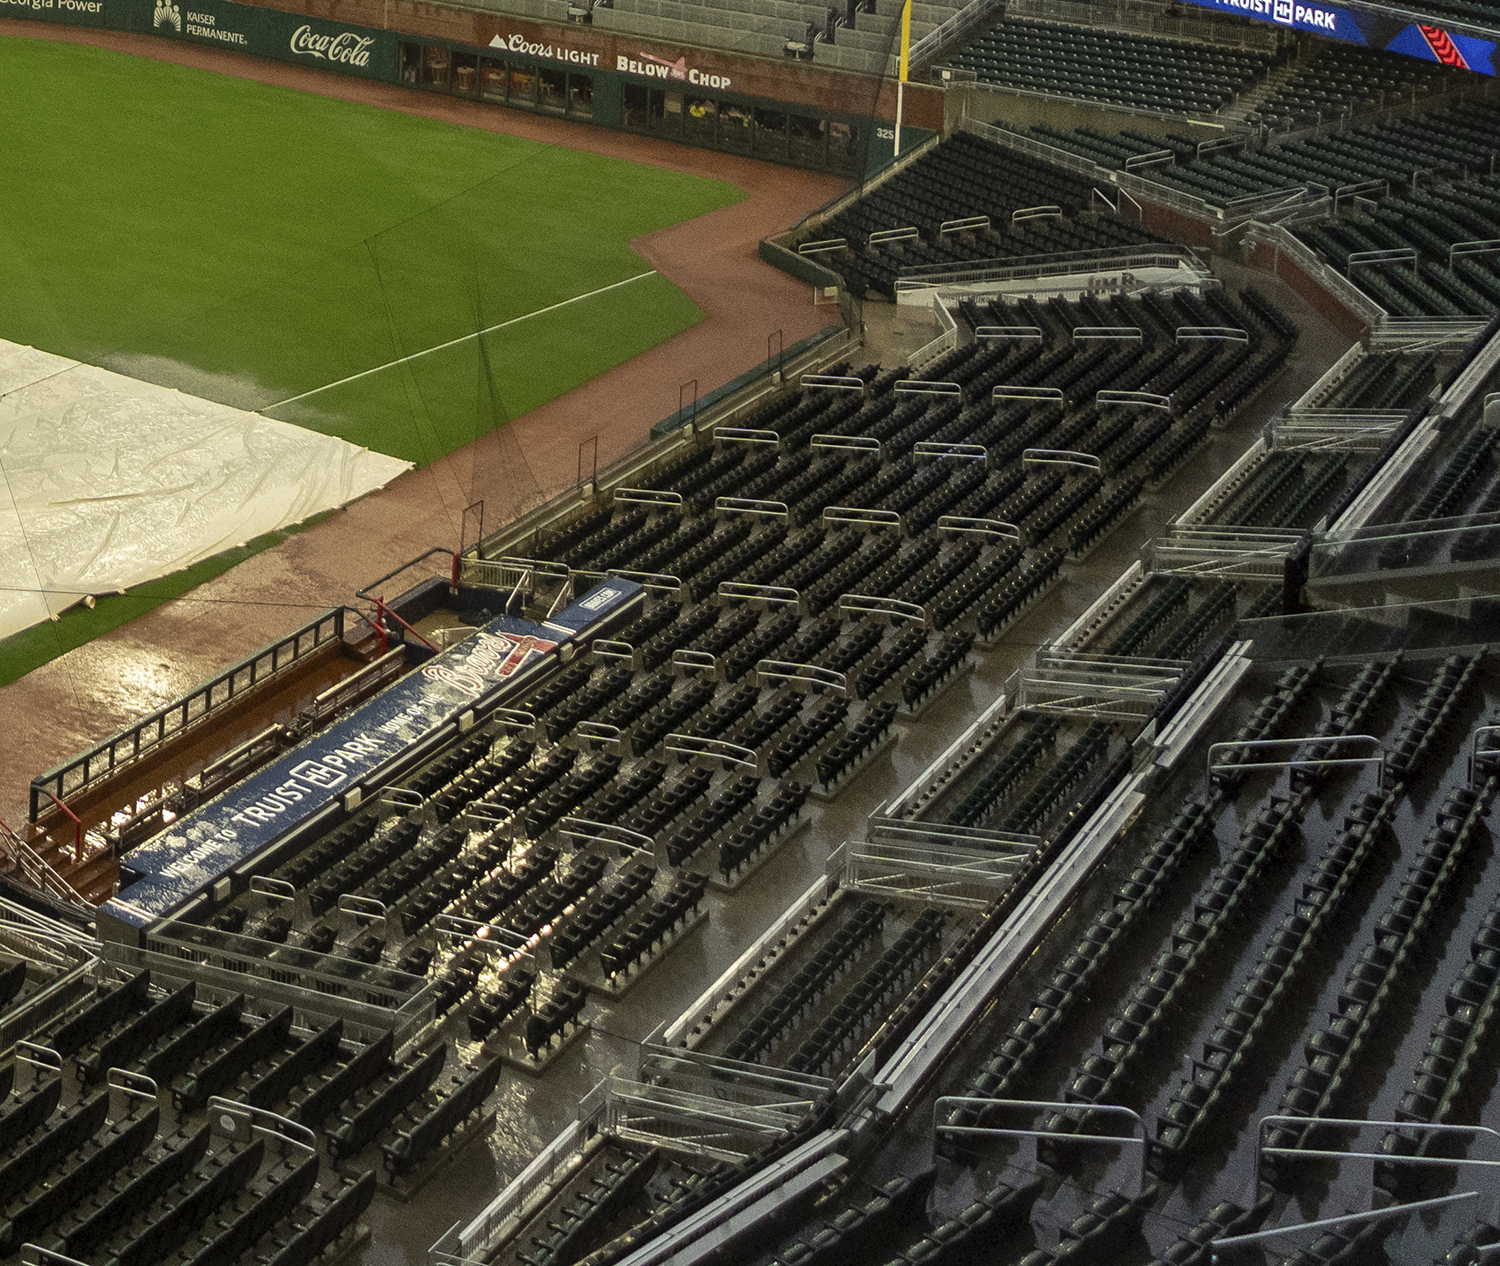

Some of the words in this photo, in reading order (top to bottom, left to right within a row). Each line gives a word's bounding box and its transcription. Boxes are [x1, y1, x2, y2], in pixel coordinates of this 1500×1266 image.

[186, 9, 216, 26] KAISER
[1294, 4, 1336, 31] PARK
[186, 23, 245, 45] PERMANENTE
[290, 23, 376, 69] Coca-Cola
[507, 33, 555, 58] Coors
[556, 47, 600, 67] LIGHT
[616, 55, 670, 79] BELOW
[687, 68, 732, 90] CHOP
[876, 126, 895, 140] 325
[159, 839, 223, 879] WELCOME
[214, 829, 238, 842] TO
[231, 778, 312, 827] TRUIST
[321, 732, 386, 770] PARK
[421, 631, 515, 700] Braves
